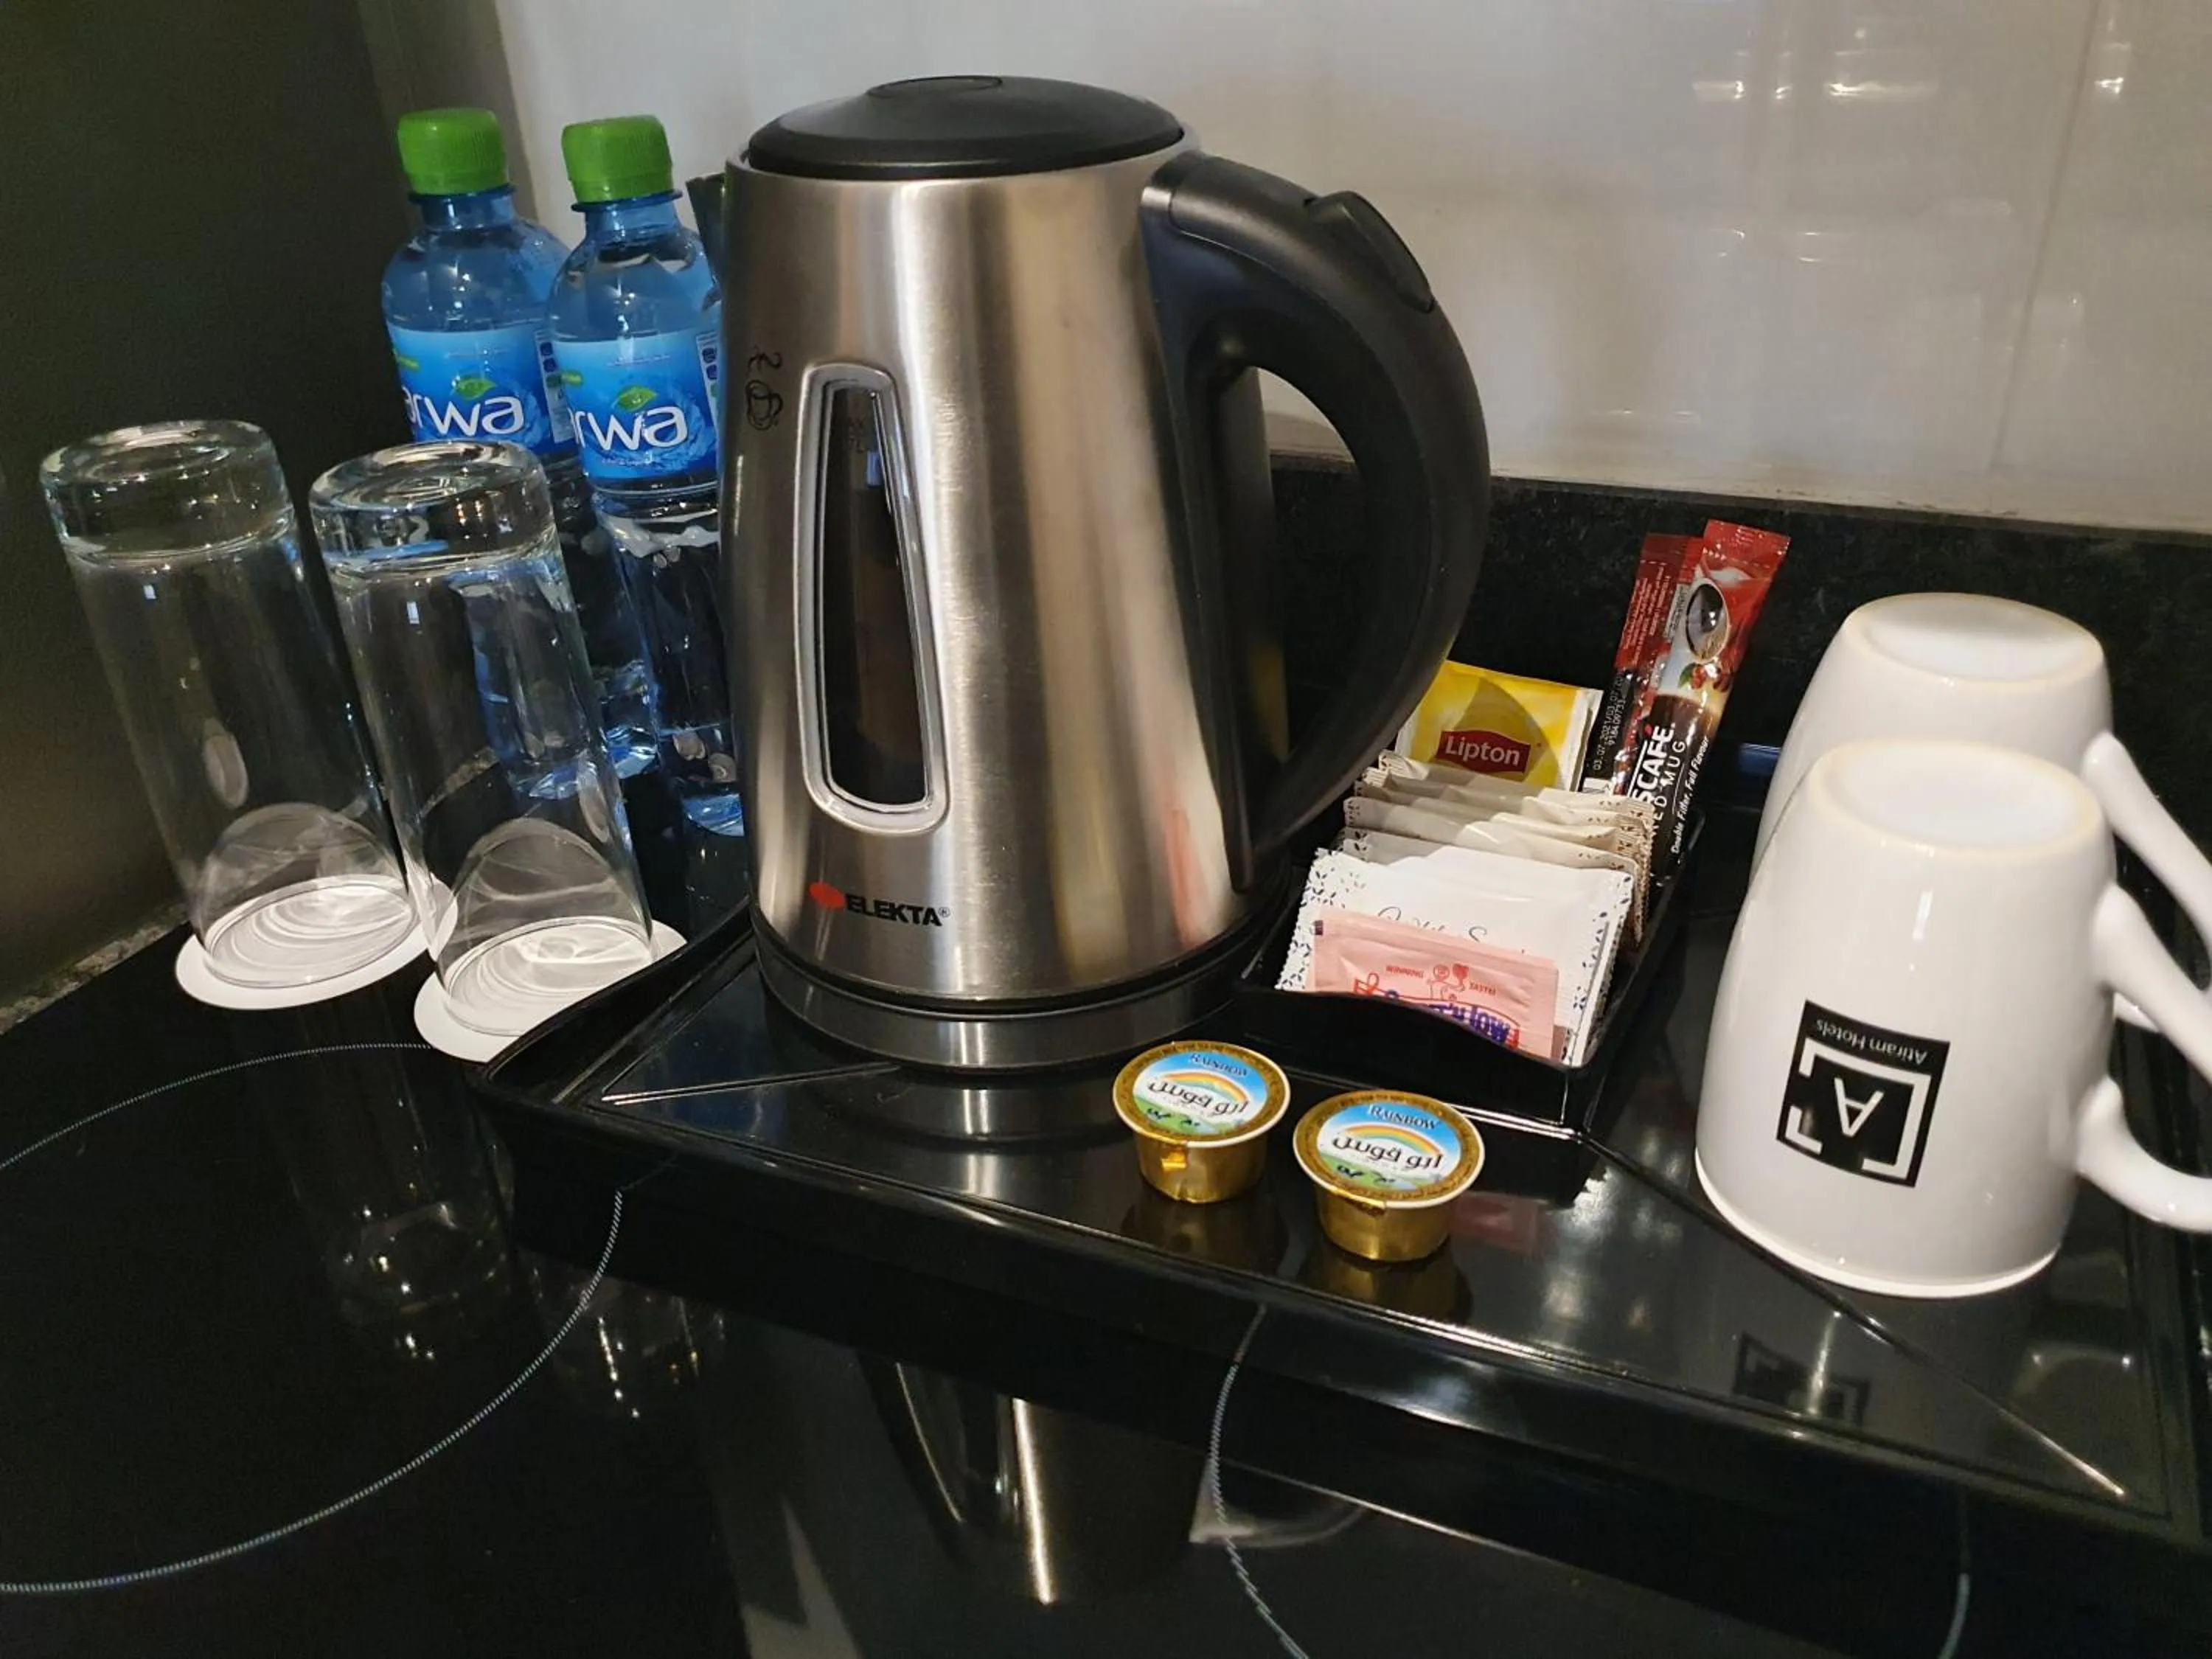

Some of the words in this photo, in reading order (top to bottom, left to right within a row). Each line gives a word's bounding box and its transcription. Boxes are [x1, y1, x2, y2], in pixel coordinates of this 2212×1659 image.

[1444, 735, 1520, 765] Lipton
[1662, 740, 1686, 785] MUG
[1691, 735, 1710, 771] Flavour
[1685, 770, 1698, 791] Full
[1816, 1019, 1867, 1051] Hotels
[1869, 1037, 1928, 1065] Atiram
[1369, 1105, 1439, 1130] RAINBOW
